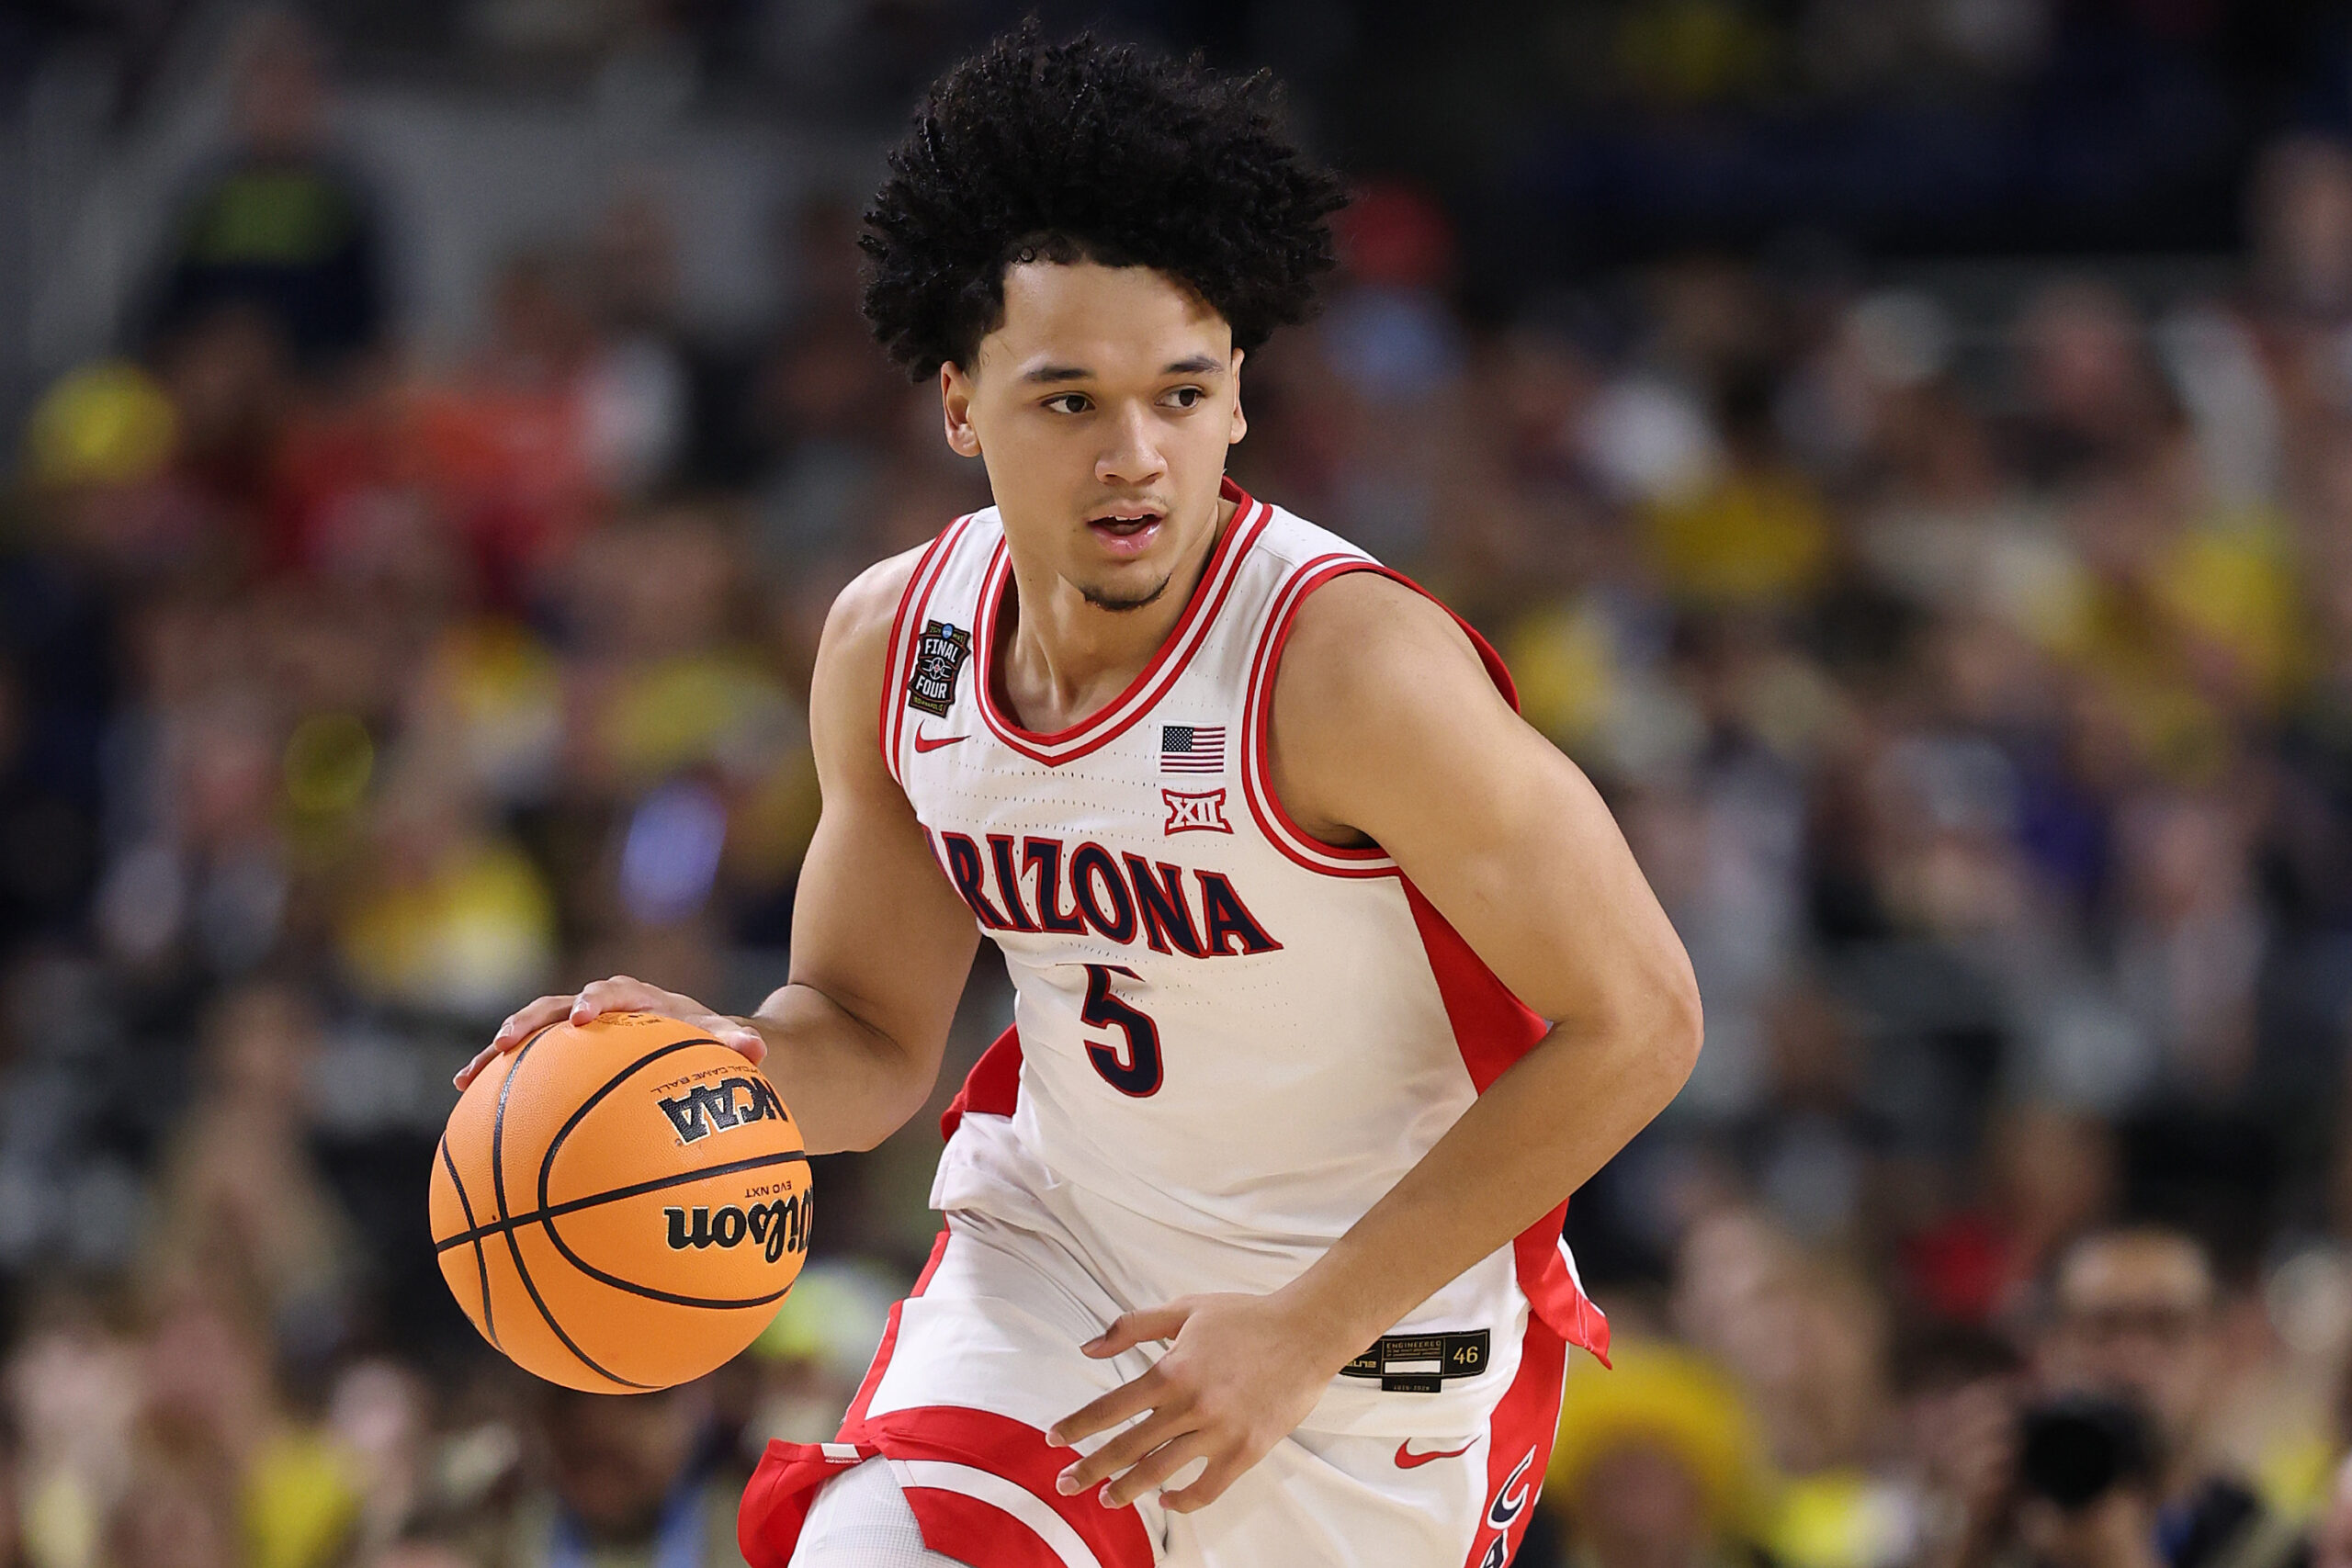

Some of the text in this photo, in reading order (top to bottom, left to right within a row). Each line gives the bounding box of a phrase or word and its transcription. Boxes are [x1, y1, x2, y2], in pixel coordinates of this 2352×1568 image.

[925, 638, 959, 663] FINAL
[915, 675, 947, 699] FOUR
[922, 827, 1284, 959] RIZONA
[1080, 964, 1164, 1098] 5
[650, 1076, 690, 1094] BALL
[692, 1066, 729, 1082] GAME
[657, 1077, 788, 1145] NCAA
[745, 1180, 792, 1199] EVO NXT
[1453, 1346, 1478, 1365] 46
